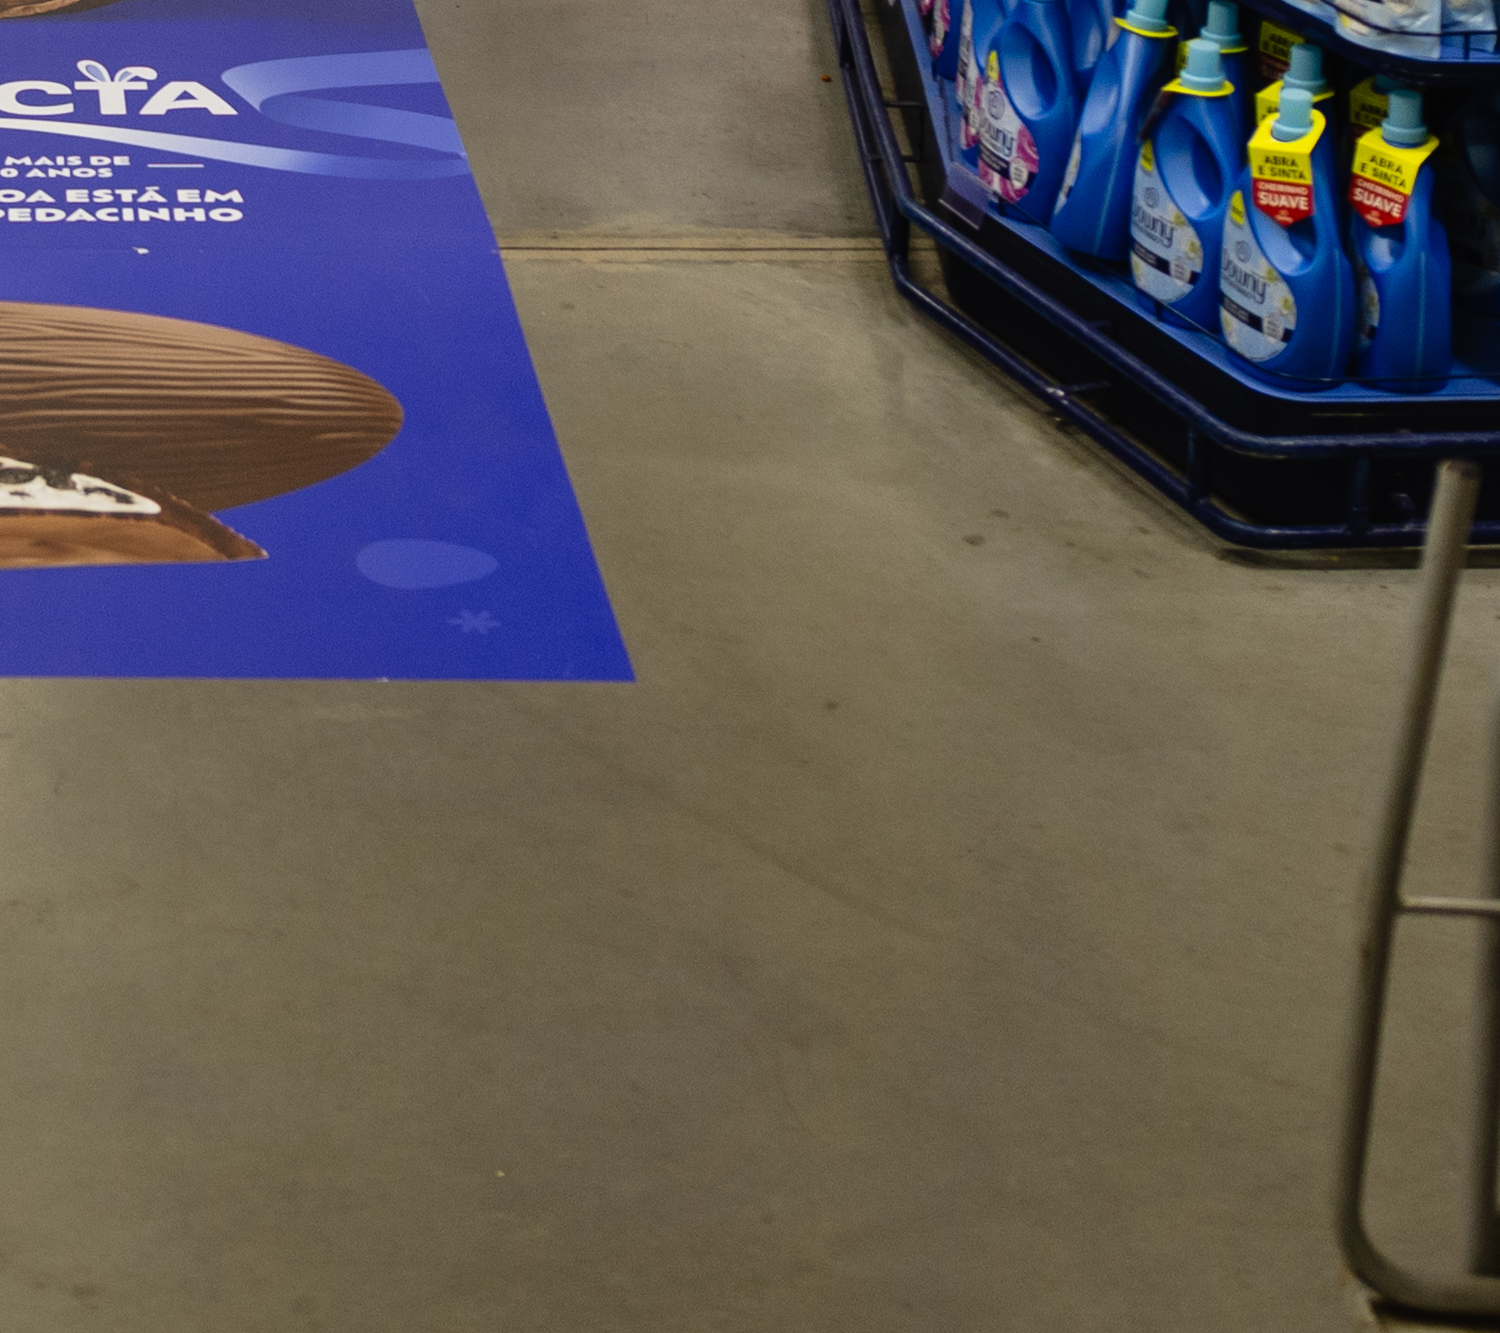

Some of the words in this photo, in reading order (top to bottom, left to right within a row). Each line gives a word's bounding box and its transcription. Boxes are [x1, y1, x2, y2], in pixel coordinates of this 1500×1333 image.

[5, 156, 82, 166] MAIS
[90, 156, 131, 166] DE
[26, 168, 113, 178] ANOS
[66, 186, 169, 203] ESTÁ
[177, 189, 245, 203] EM
